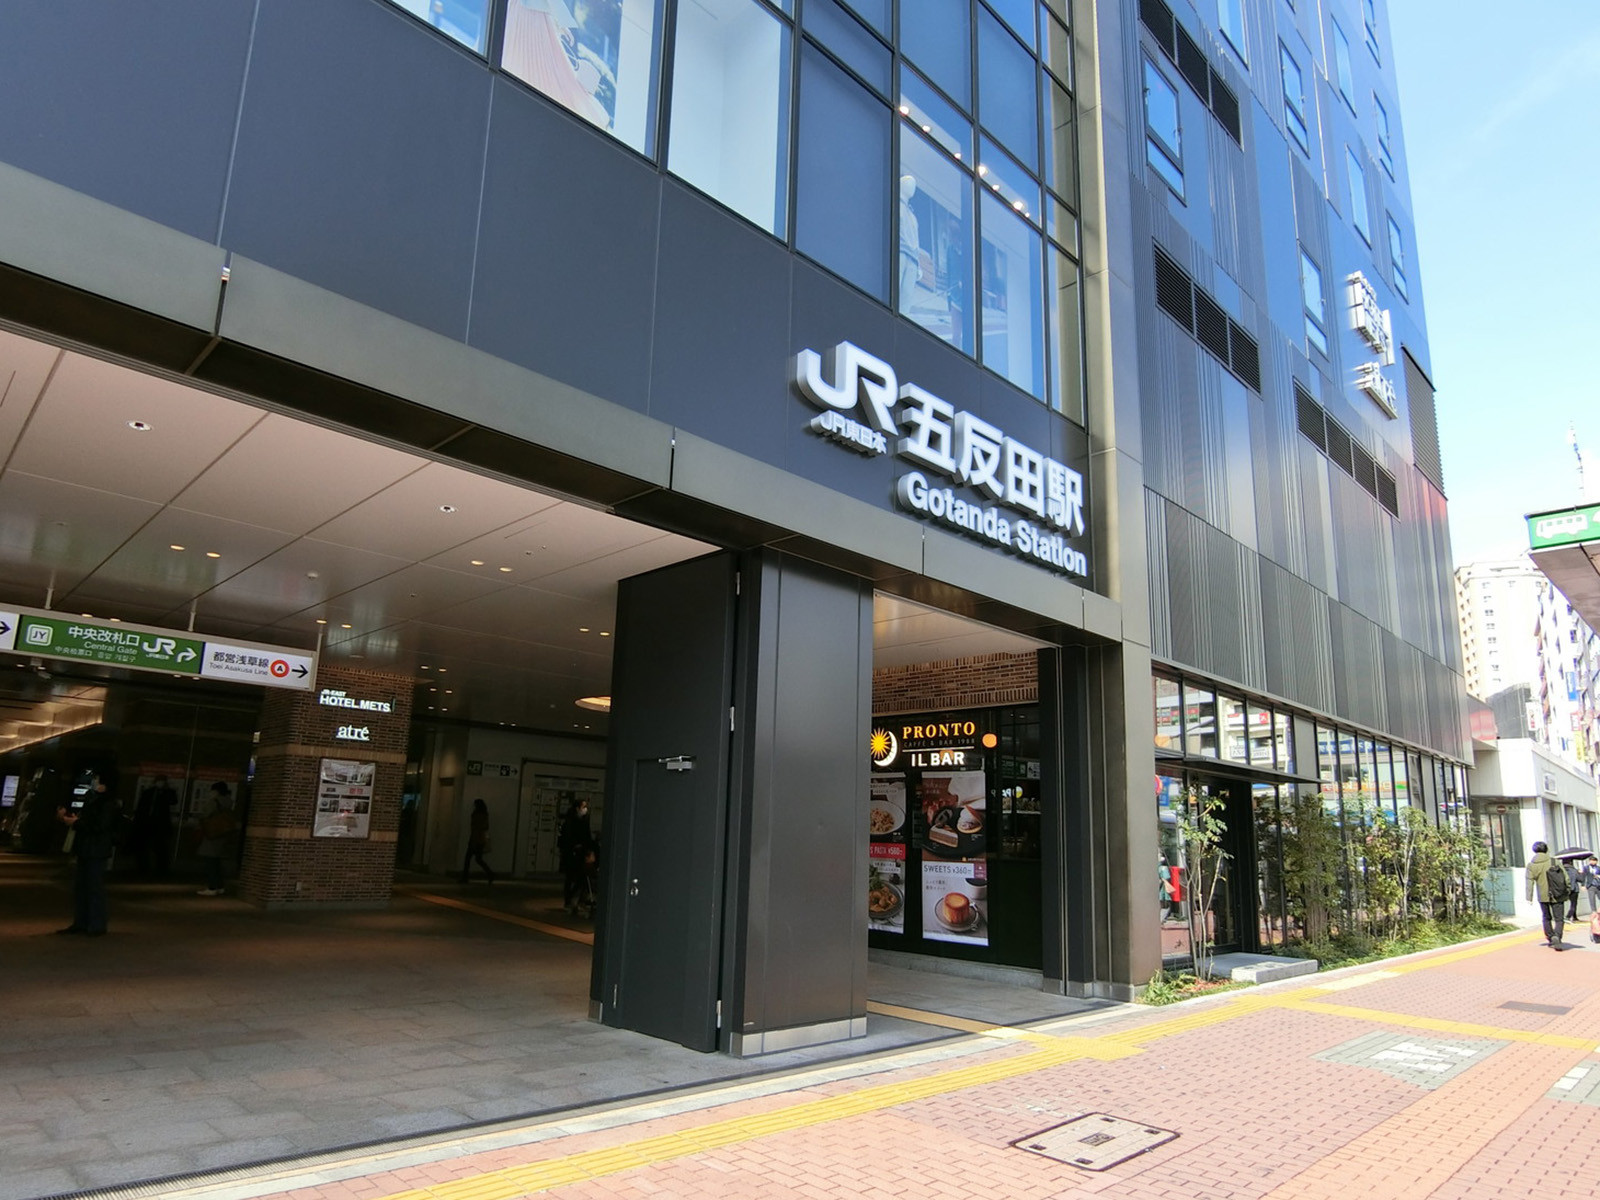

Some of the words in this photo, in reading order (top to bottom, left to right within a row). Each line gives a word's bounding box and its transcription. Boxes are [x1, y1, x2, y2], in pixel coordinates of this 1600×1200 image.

[797, 340, 898, 436] JR
[811, 410, 886, 454] JR東日本
[898, 382, 1085, 537] 五反田駅
[898, 471, 1012, 546] Gotanda
[1012, 519, 1087, 577] Station
[32, 630, 47, 640] JY
[68, 625, 140, 647] 中央改札口
[84, 641, 116, 652] Central
[117, 645, 138, 655] Gate
[142, 637, 176, 656] JR
[213, 651, 270, 668] 都営浅草線
[209, 662, 223, 670] Toei
[225, 664, 253, 674] Asakusa
[254, 668, 269, 677] Line
[319, 695, 359, 708] HOTEL
[359, 699, 392, 712] METS
[336, 724, 370, 740] atré
[902, 721, 976, 739] PRONTO
[911, 753, 928, 767] IL
[930, 751, 965, 767] BAR
[923, 864, 951, 874] SWEETS
